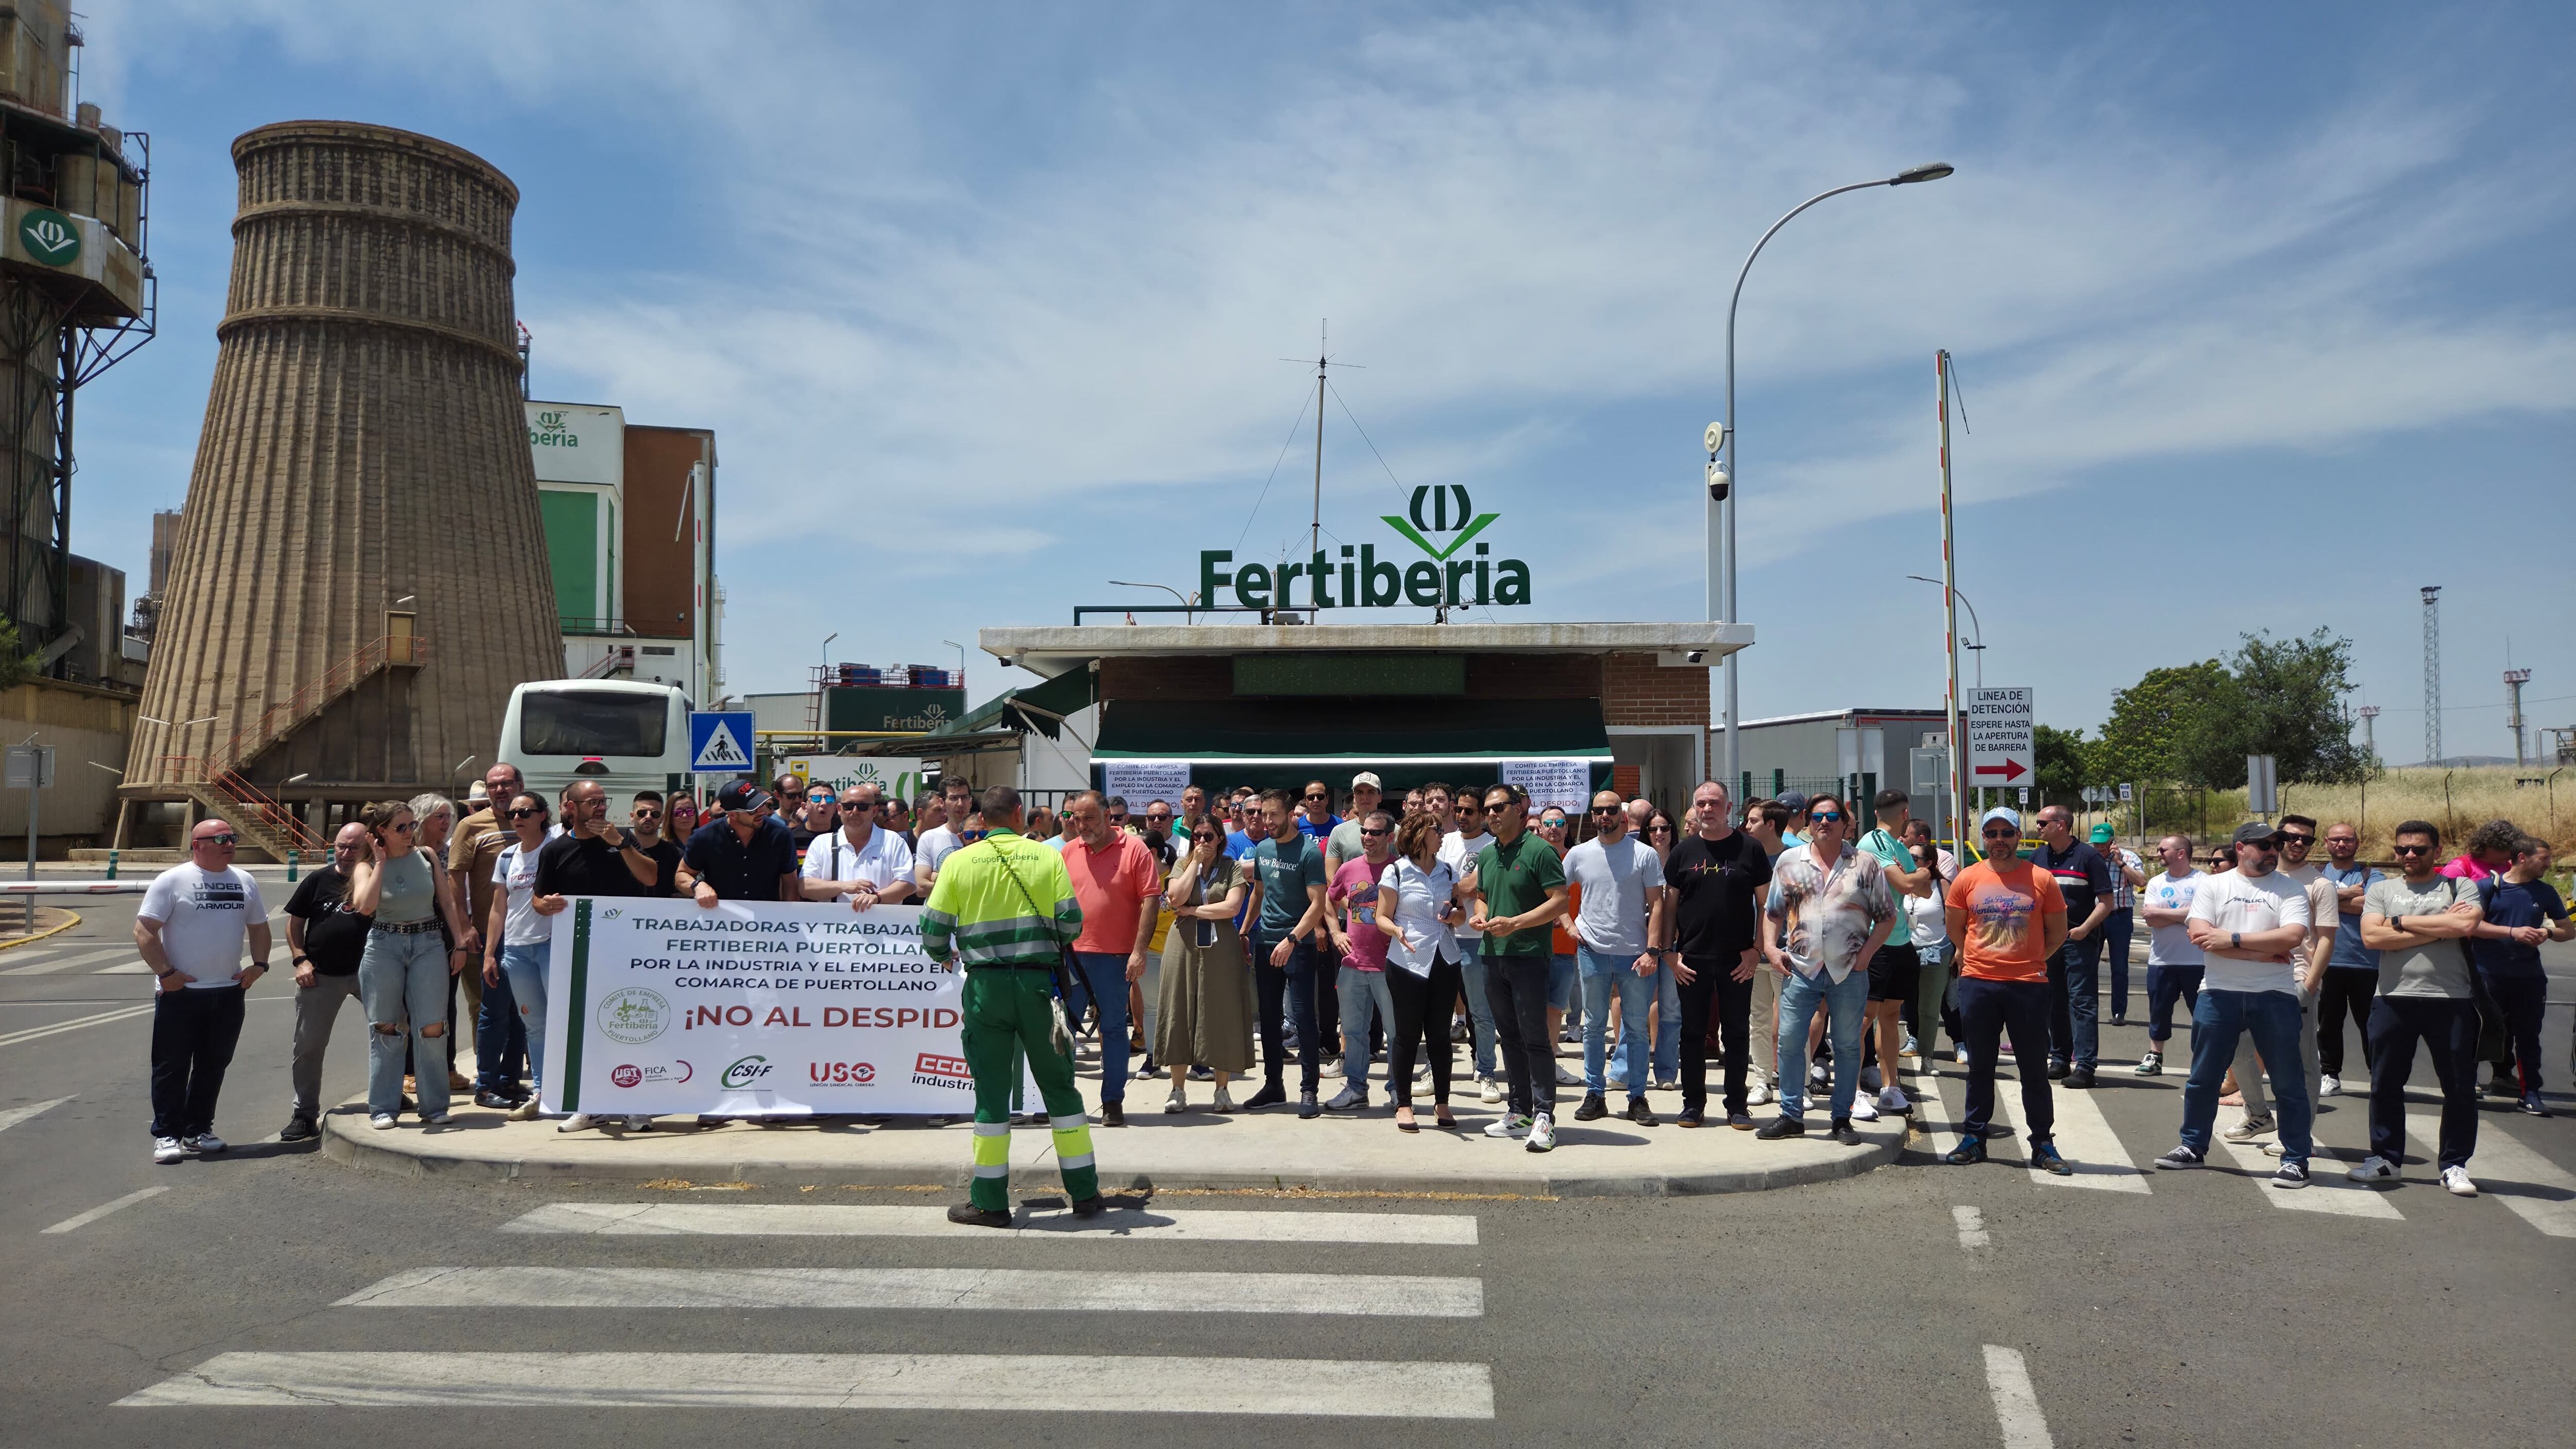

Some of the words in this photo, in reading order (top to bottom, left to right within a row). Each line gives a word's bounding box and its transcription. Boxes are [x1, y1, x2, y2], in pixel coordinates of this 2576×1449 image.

[1201, 543, 1531, 608] Fertiberia
[1978, 691, 2006, 701] LINEA
[2010, 691, 2023, 700] DE
[1972, 702, 2029, 714] DETENCIÓN
[1971, 721, 2003, 729] ESPERE
[2005, 720, 2030, 728] HASTA
[810, 777, 887, 791] tibia
[1259, 856, 1270, 866] New
[1272, 858, 1297, 871] Balance
[193, 882, 244, 891] UNDER
[632, 918, 800, 933] TRABAJADORAS
[806, 922, 819, 933] Y
[667, 939, 789, 953] FERTIBERIA
[631, 958, 670, 969] POR
[677, 959, 700, 970] LA
[706, 960, 803, 971] INDUSTRIA
[808, 961, 820, 972] Y
[824, 961, 845, 973] EL
[851, 962, 924, 973] EMPLEO
[675, 977, 769, 989] COMARCA
[775, 978, 799, 989] DE
[805, 979, 937, 991] PUERTOLLANO
[639, 990, 666, 1010] EMPRESA
[685, 1005, 753, 1030] ¡NO
[764, 1007, 811, 1027] AL
[824, 1007, 964, 1028] DESPID
[608, 1030, 658, 1042] PUERTOLLANO
[615, 1067, 639, 1081] UGT
[645, 1066, 667, 1075] FICA
[810, 1062, 876, 1082] USO
[912, 1072, 976, 1091] industri
